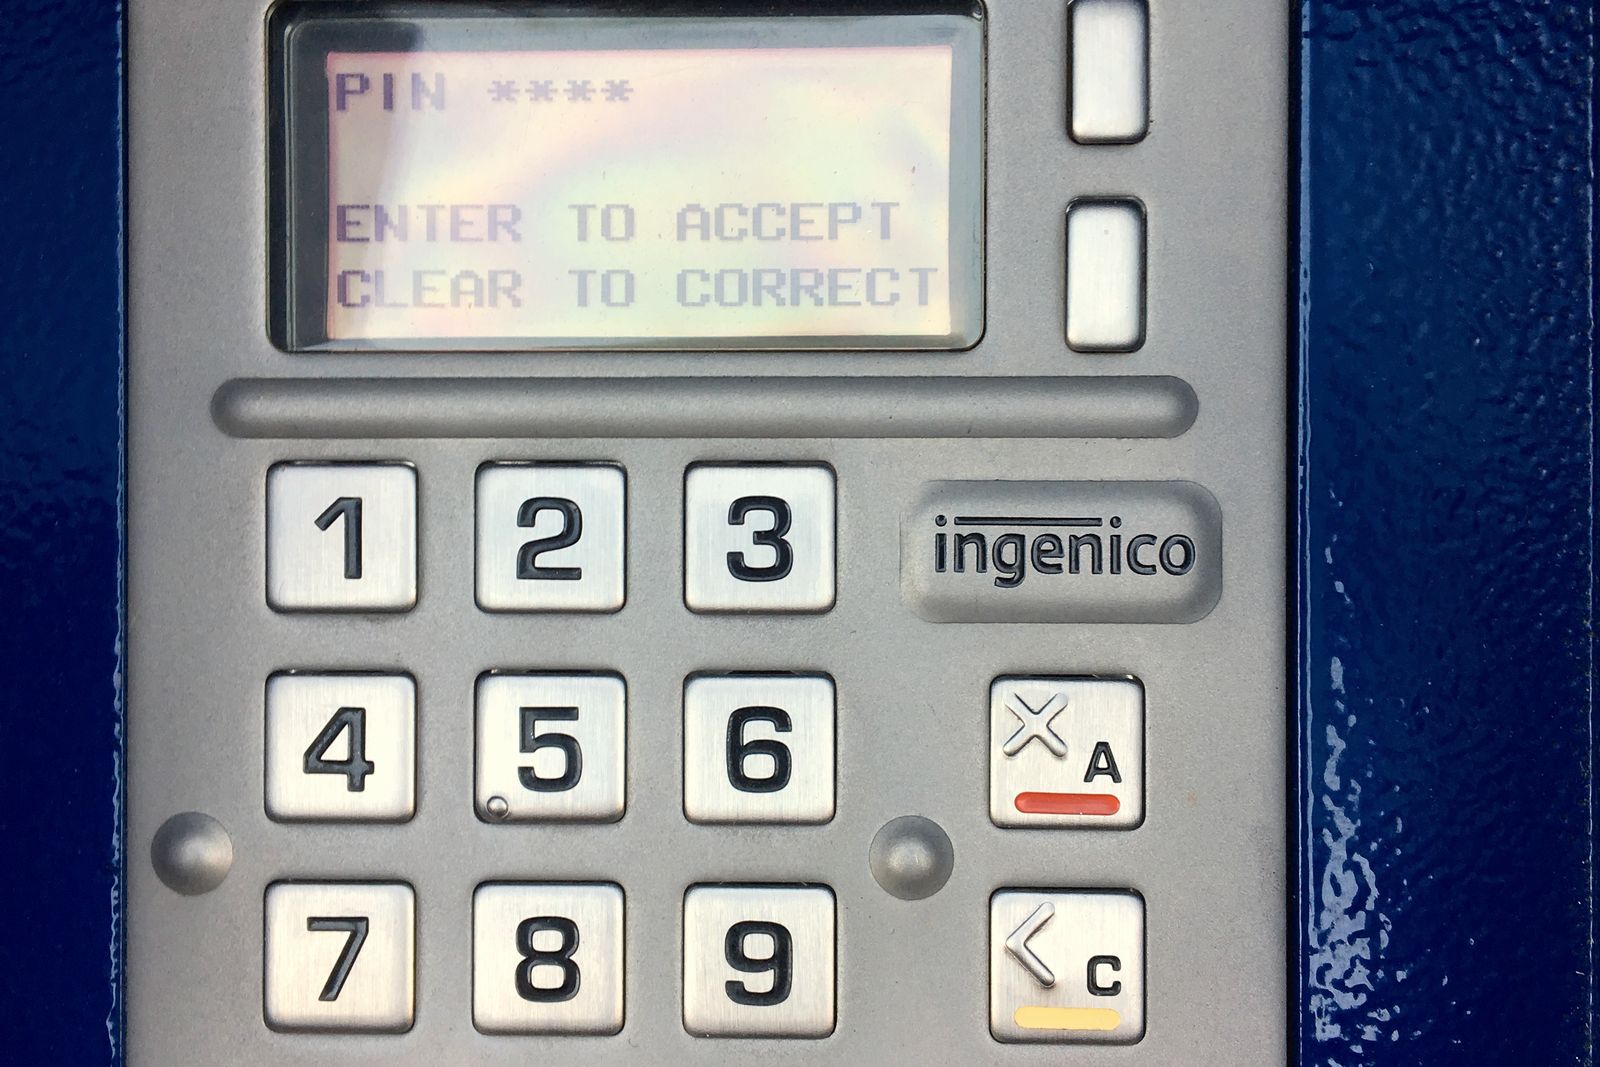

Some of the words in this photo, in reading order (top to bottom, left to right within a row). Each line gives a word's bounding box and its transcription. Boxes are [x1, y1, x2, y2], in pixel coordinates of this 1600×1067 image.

[335, 73, 446, 111] PIN
[336, 204, 522, 242] ENTER
[567, 204, 635, 242] TO
[676, 202, 900, 241] ACCEPT
[337, 270, 522, 308] CLEAR
[567, 270, 635, 308] TO
[676, 268, 938, 307] CORRECT
[315, 497, 362, 579] 1
[517, 497, 582, 580] 2
[727, 496, 793, 582] 3
[935, 514, 1196, 589] ingenico
[304, 707, 374, 792] 4
[518, 707, 582, 792] 5
[726, 706, 792, 793] 6
[1084, 742, 1121, 783] A
[307, 917, 369, 1001] 7
[516, 916, 580, 1002] 8
[725, 921, 793, 1006] 9
[1087, 955, 1121, 996] C
